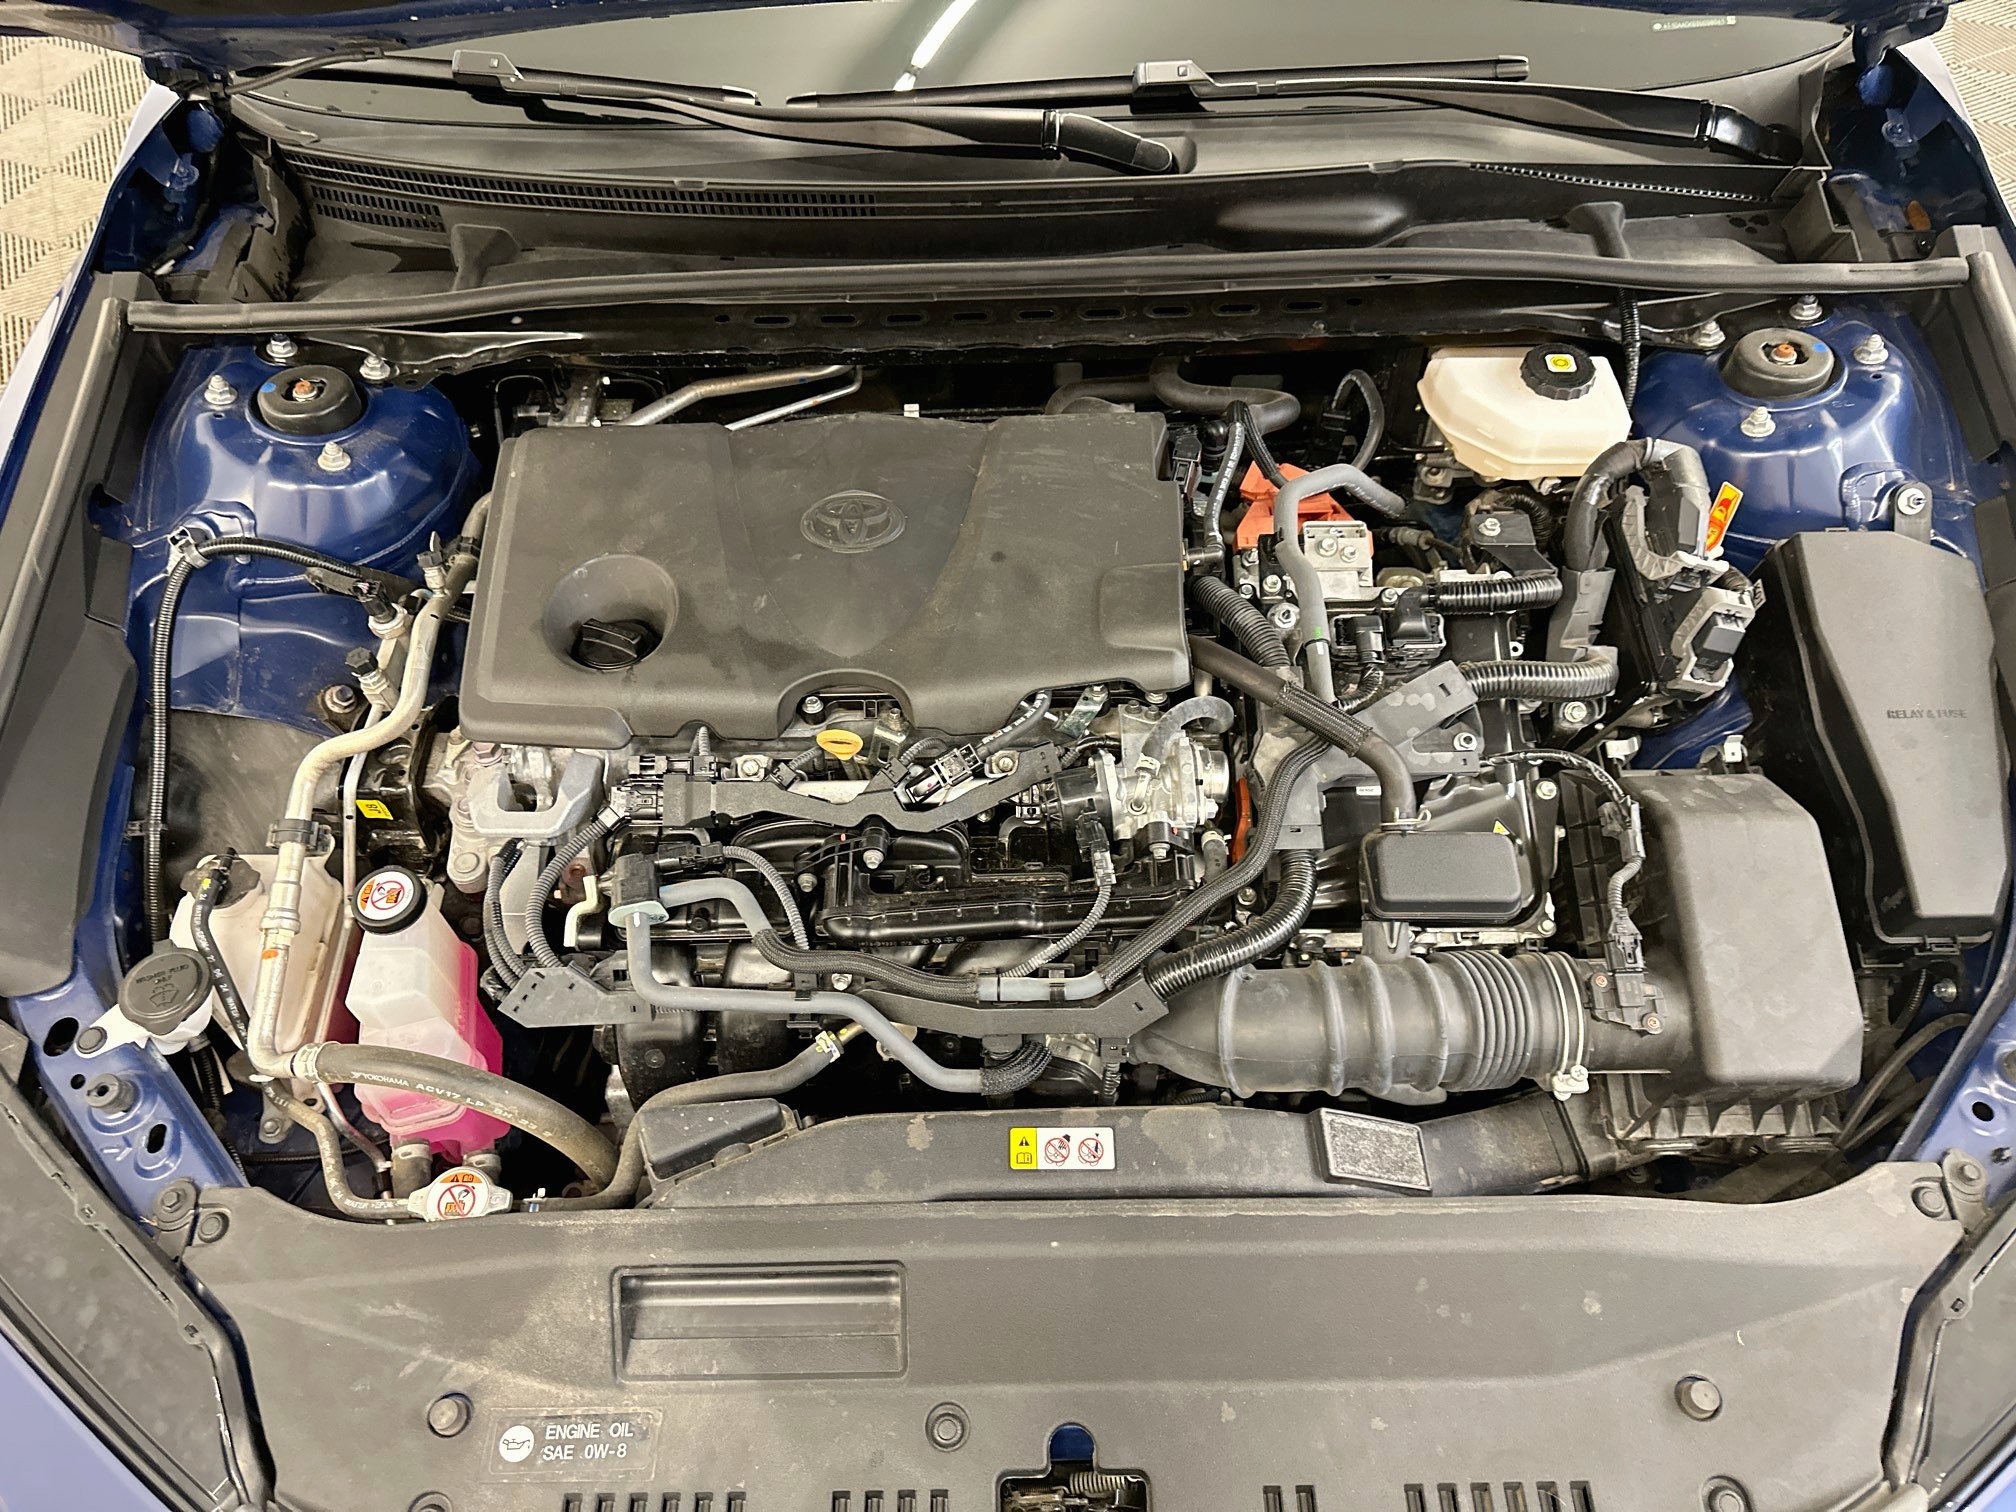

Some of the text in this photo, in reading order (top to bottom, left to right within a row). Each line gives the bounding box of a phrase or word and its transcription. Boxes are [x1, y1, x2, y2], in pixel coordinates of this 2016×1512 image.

[1886, 709, 1924, 719] RELAY
[1936, 709, 1968, 719] FUSE
[226, 996, 240, 1018] WATER
[362, 1072, 410, 1087] YOKOHAMA
[415, 1083, 461, 1099] ACV17
[545, 1422, 634, 1440] ENGINE OIL
[542, 1443, 628, 1461] SAE 0W-8
